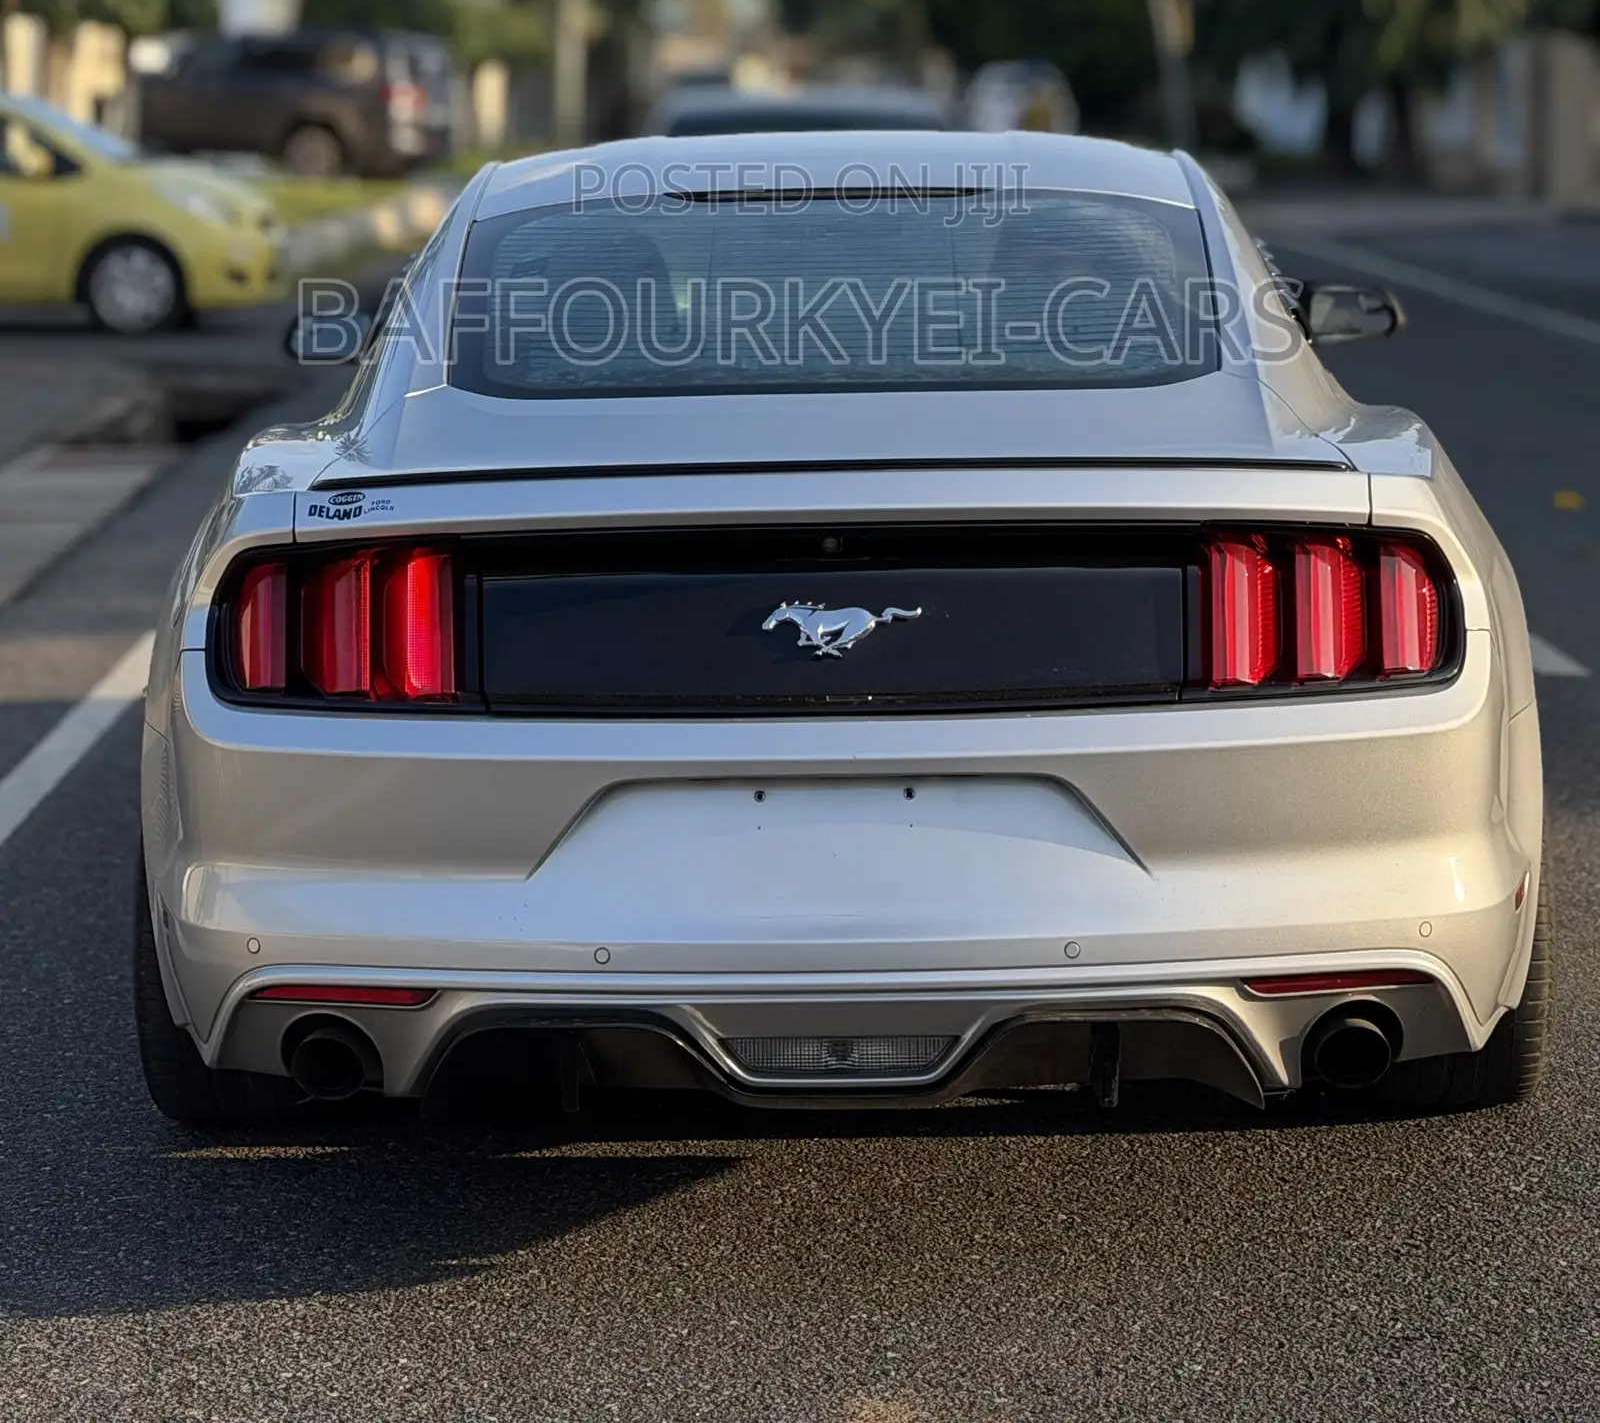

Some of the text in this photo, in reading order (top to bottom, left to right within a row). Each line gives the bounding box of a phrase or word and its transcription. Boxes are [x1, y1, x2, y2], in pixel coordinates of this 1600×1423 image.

[329, 493, 365, 504] COGGIN
[308, 504, 363, 521] DELAND
[363, 505, 395, 514] LINCOLN
